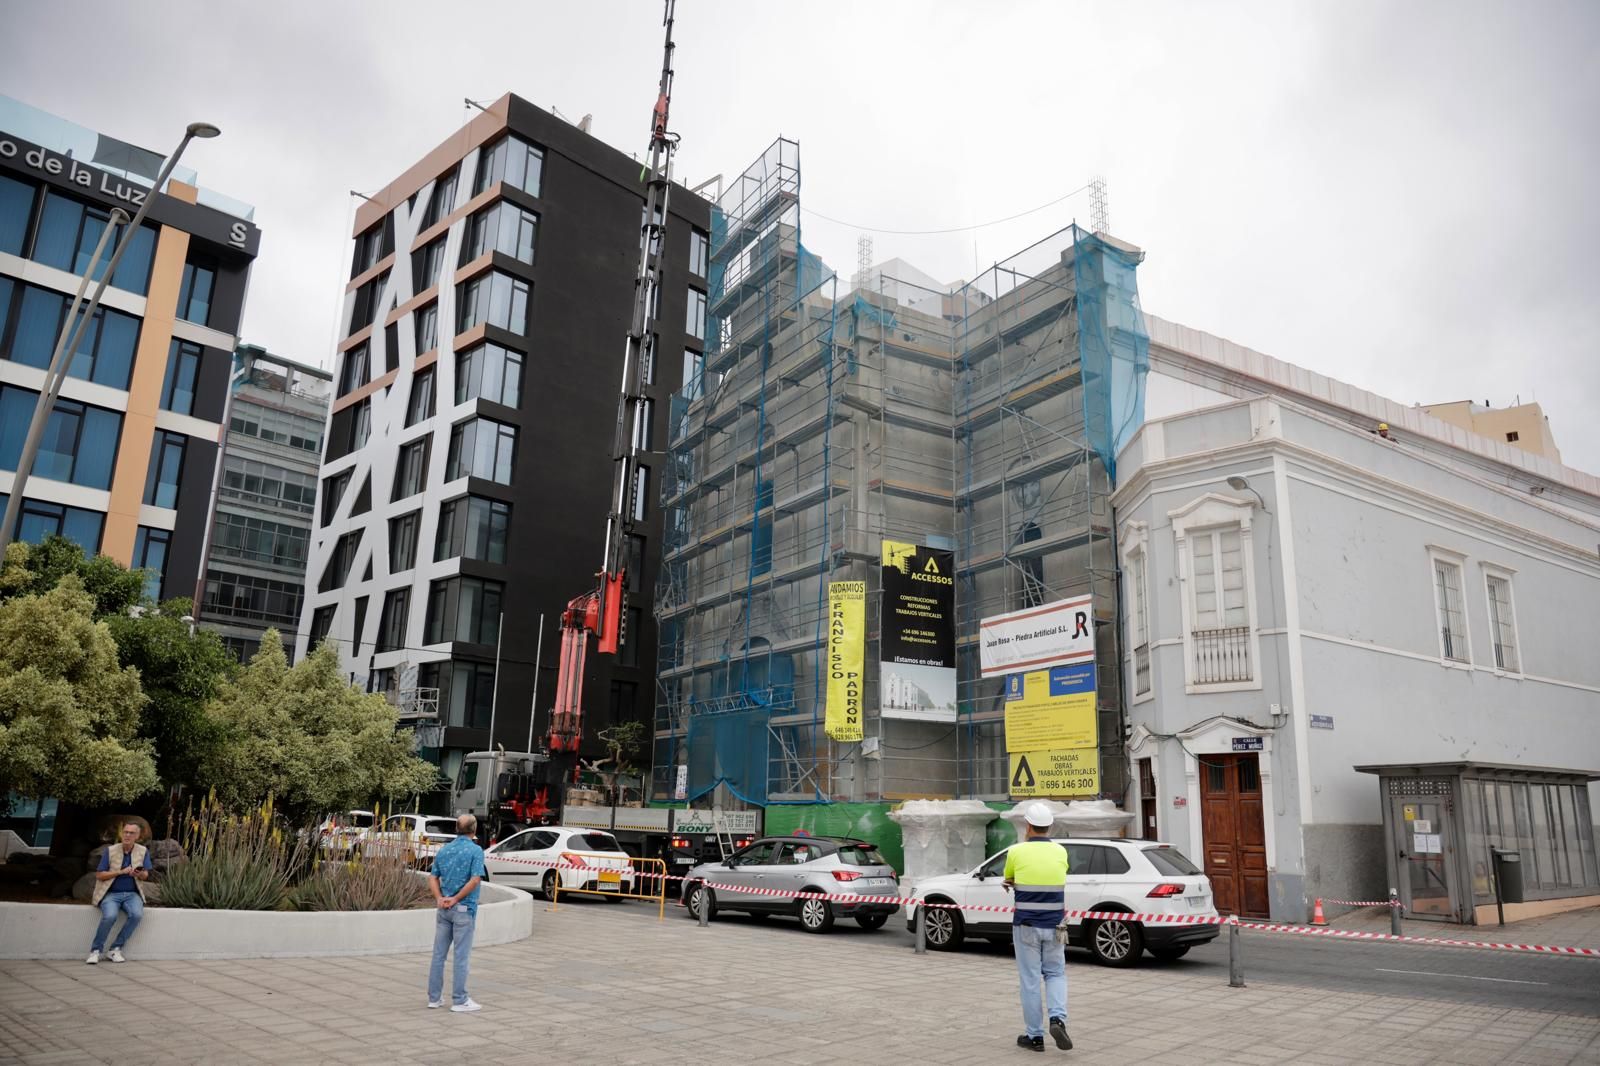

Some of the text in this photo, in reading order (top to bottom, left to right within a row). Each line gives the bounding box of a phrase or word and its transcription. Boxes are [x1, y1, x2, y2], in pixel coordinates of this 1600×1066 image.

[25, 148, 63, 174] de
[69, 160, 92, 187] la
[100, 173, 147, 206] Luz
[911, 572, 953, 585] ACCESSOS
[830, 583, 864, 594] ANDAMIOS
[907, 602, 931, 611] REFORMAS
[895, 608, 942, 619] TRABAJOS VERTICALES
[832, 602, 844, 679] FRANCISCO
[986, 639, 997, 648] Juan
[998, 637, 1010, 645] Rosa
[1016, 633, 1033, 642] Piedra
[1034, 628, 1057, 638] Artificial
[1058, 625, 1069, 633] S.L.
[894, 656, 919, 665] ¡Estamos
[926, 658, 943, 667] obras!
[1050, 754, 1079, 762] FACHADAS
[1063, 767, 1097, 775] VERTICALES
[1046, 778, 1094, 789] 696 146 300
